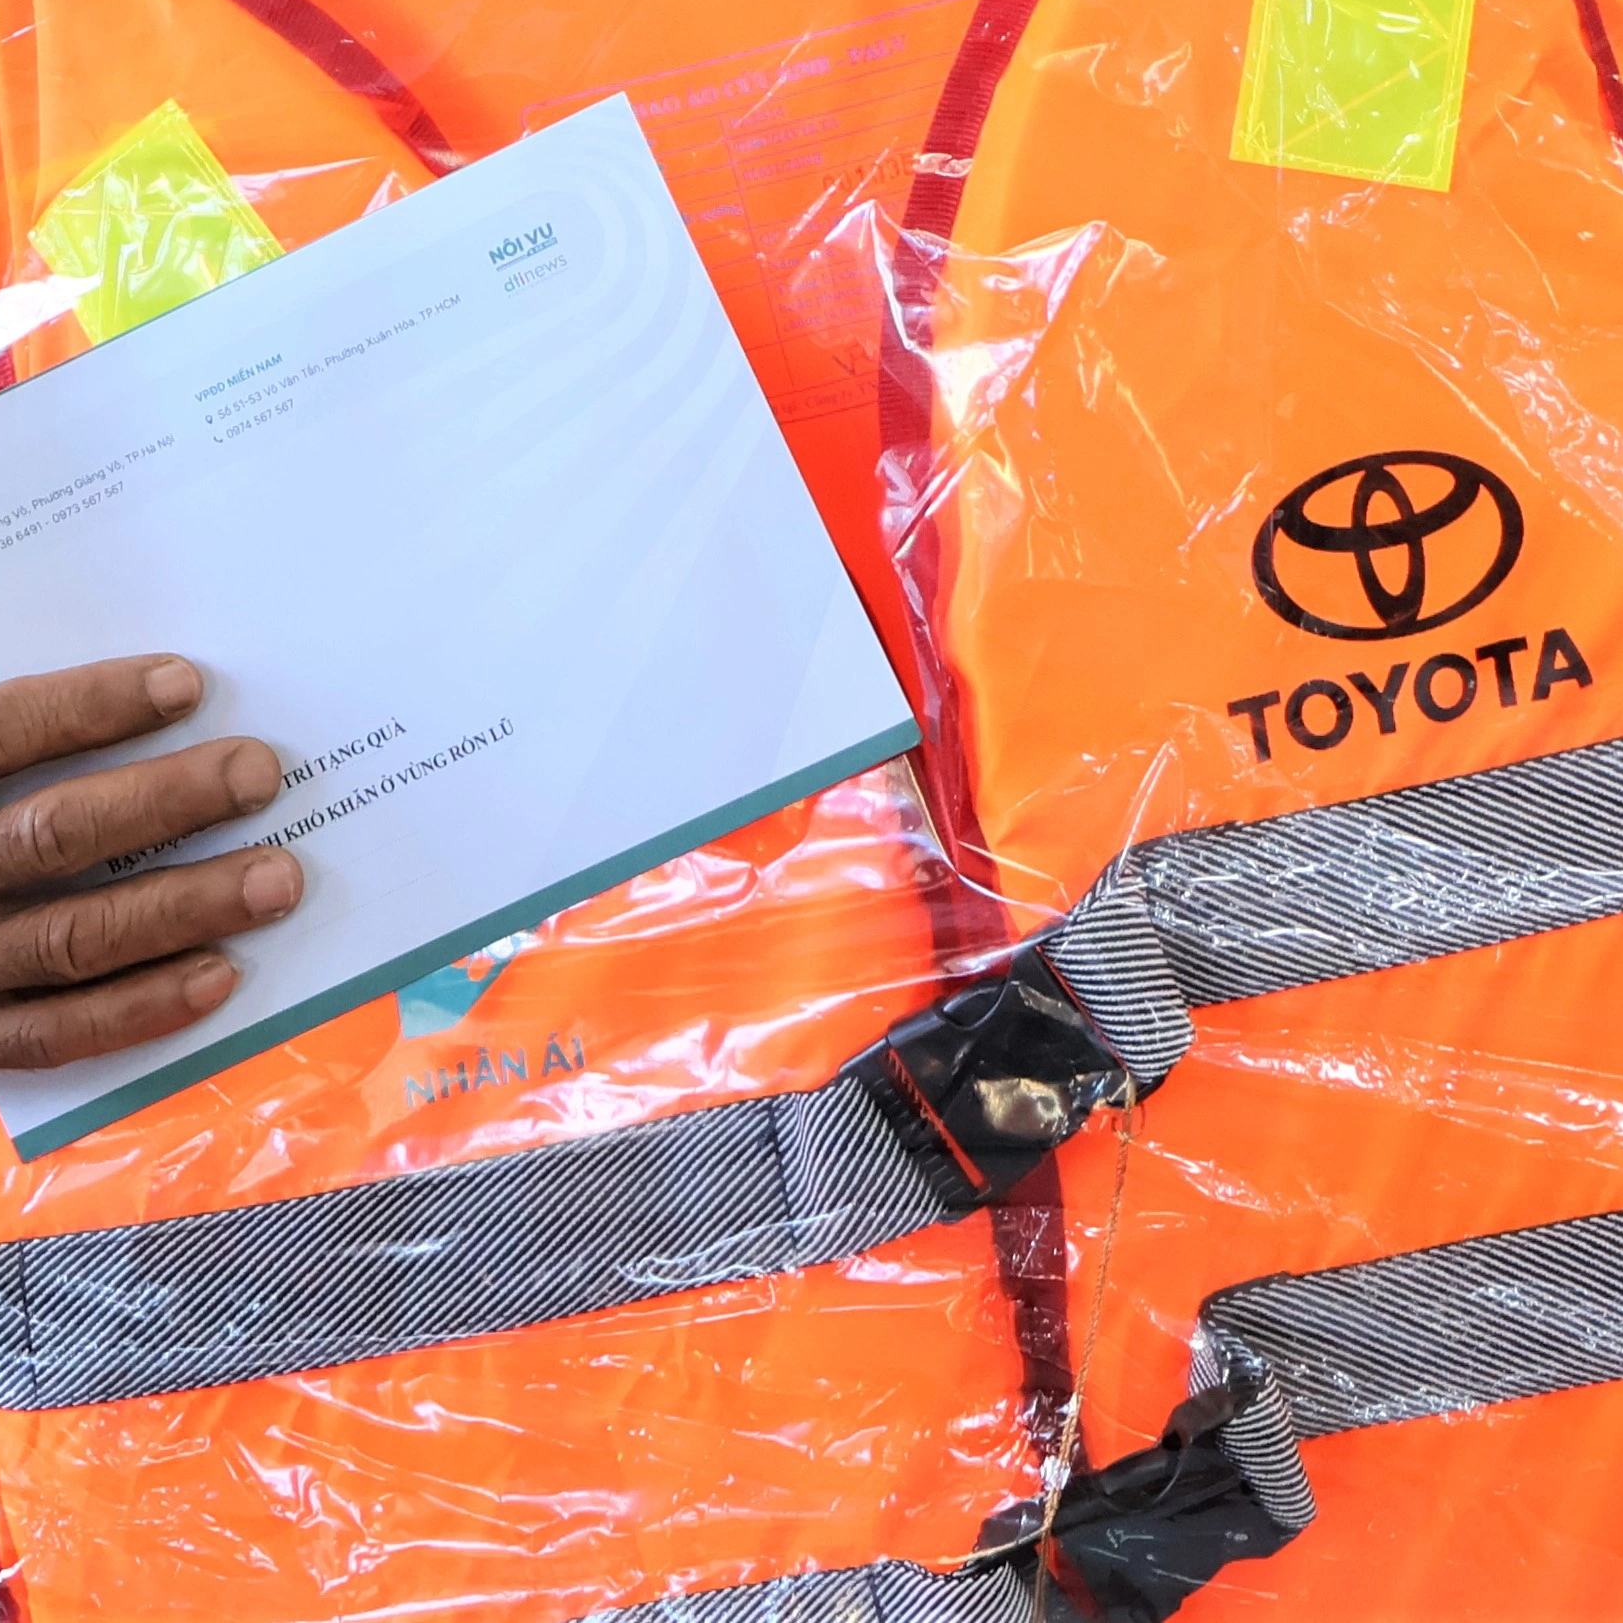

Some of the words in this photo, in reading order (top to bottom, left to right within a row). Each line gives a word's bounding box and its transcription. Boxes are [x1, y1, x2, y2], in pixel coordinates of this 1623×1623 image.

[256, 354, 282, 373] NAM
[226, 420, 252, 438] 0974
[254, 409, 272, 425] 567
[275, 398, 293, 414] 567
[16, 521, 42, 541] 6491
[52, 503, 80, 523] 0973
[82, 492, 101, 509] 567
[104, 481, 123, 498] 567
[1228, 628, 1593, 764] TOYOTA
[279, 760, 314, 789] TRÍ
[367, 717, 406, 748] QUÀ
[284, 809, 324, 842] KHÓ
[381, 775, 395, 793] Ở
[396, 753, 447, 784] VÙNG
[489, 718, 513, 742] LŨ
[404, 1047, 528, 1109] NHÂN
[542, 1032, 585, 1077] ÁI
